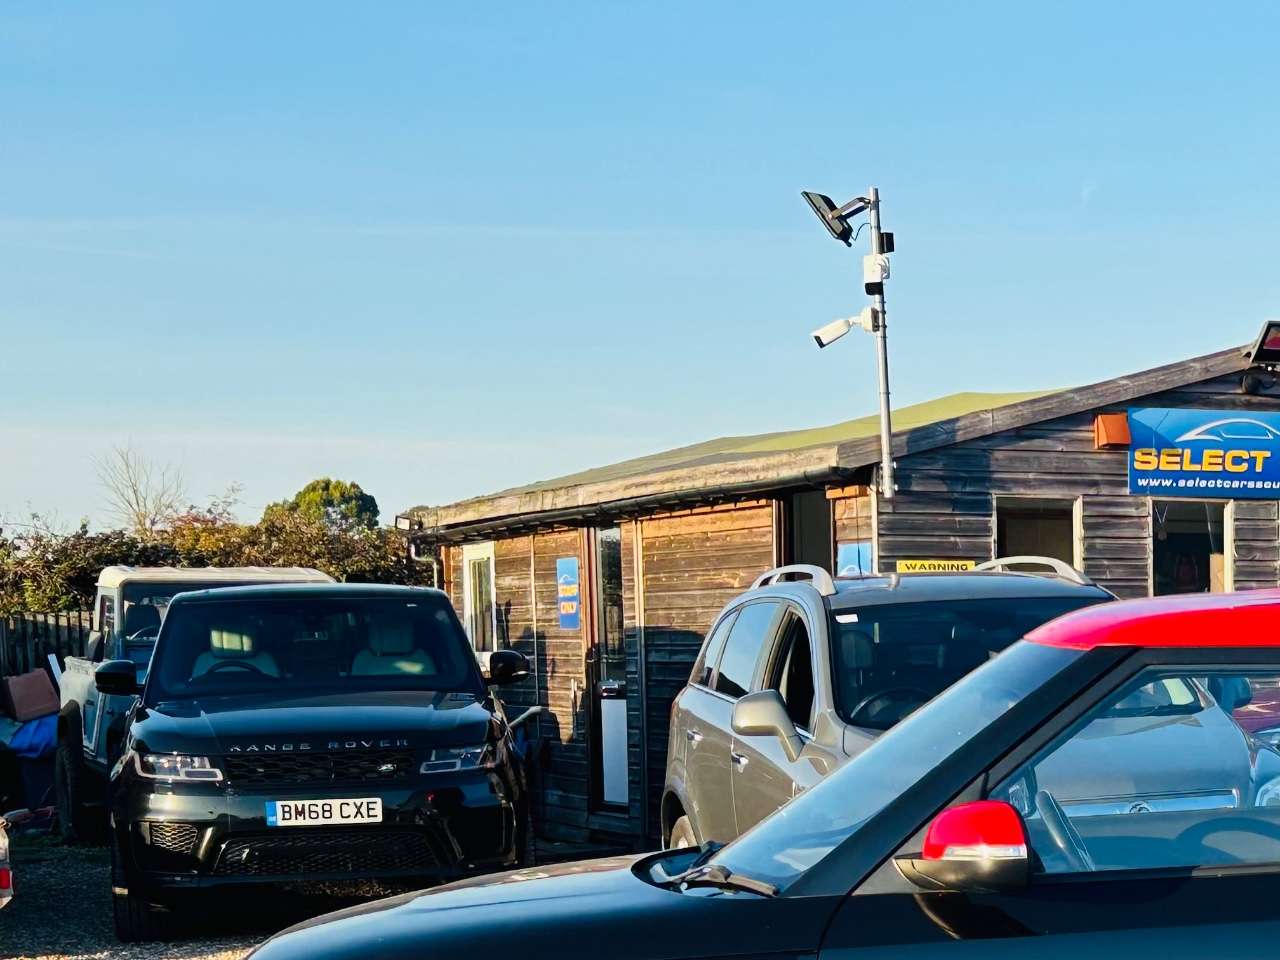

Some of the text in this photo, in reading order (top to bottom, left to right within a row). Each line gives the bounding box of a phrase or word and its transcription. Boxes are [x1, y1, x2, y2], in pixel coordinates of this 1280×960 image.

[1133, 447, 1272, 473] SELECT
[904, 563, 969, 571] WARNING
[230, 739, 408, 751] RANGE ROVER
[280, 801, 378, 821] BM68 CXE
